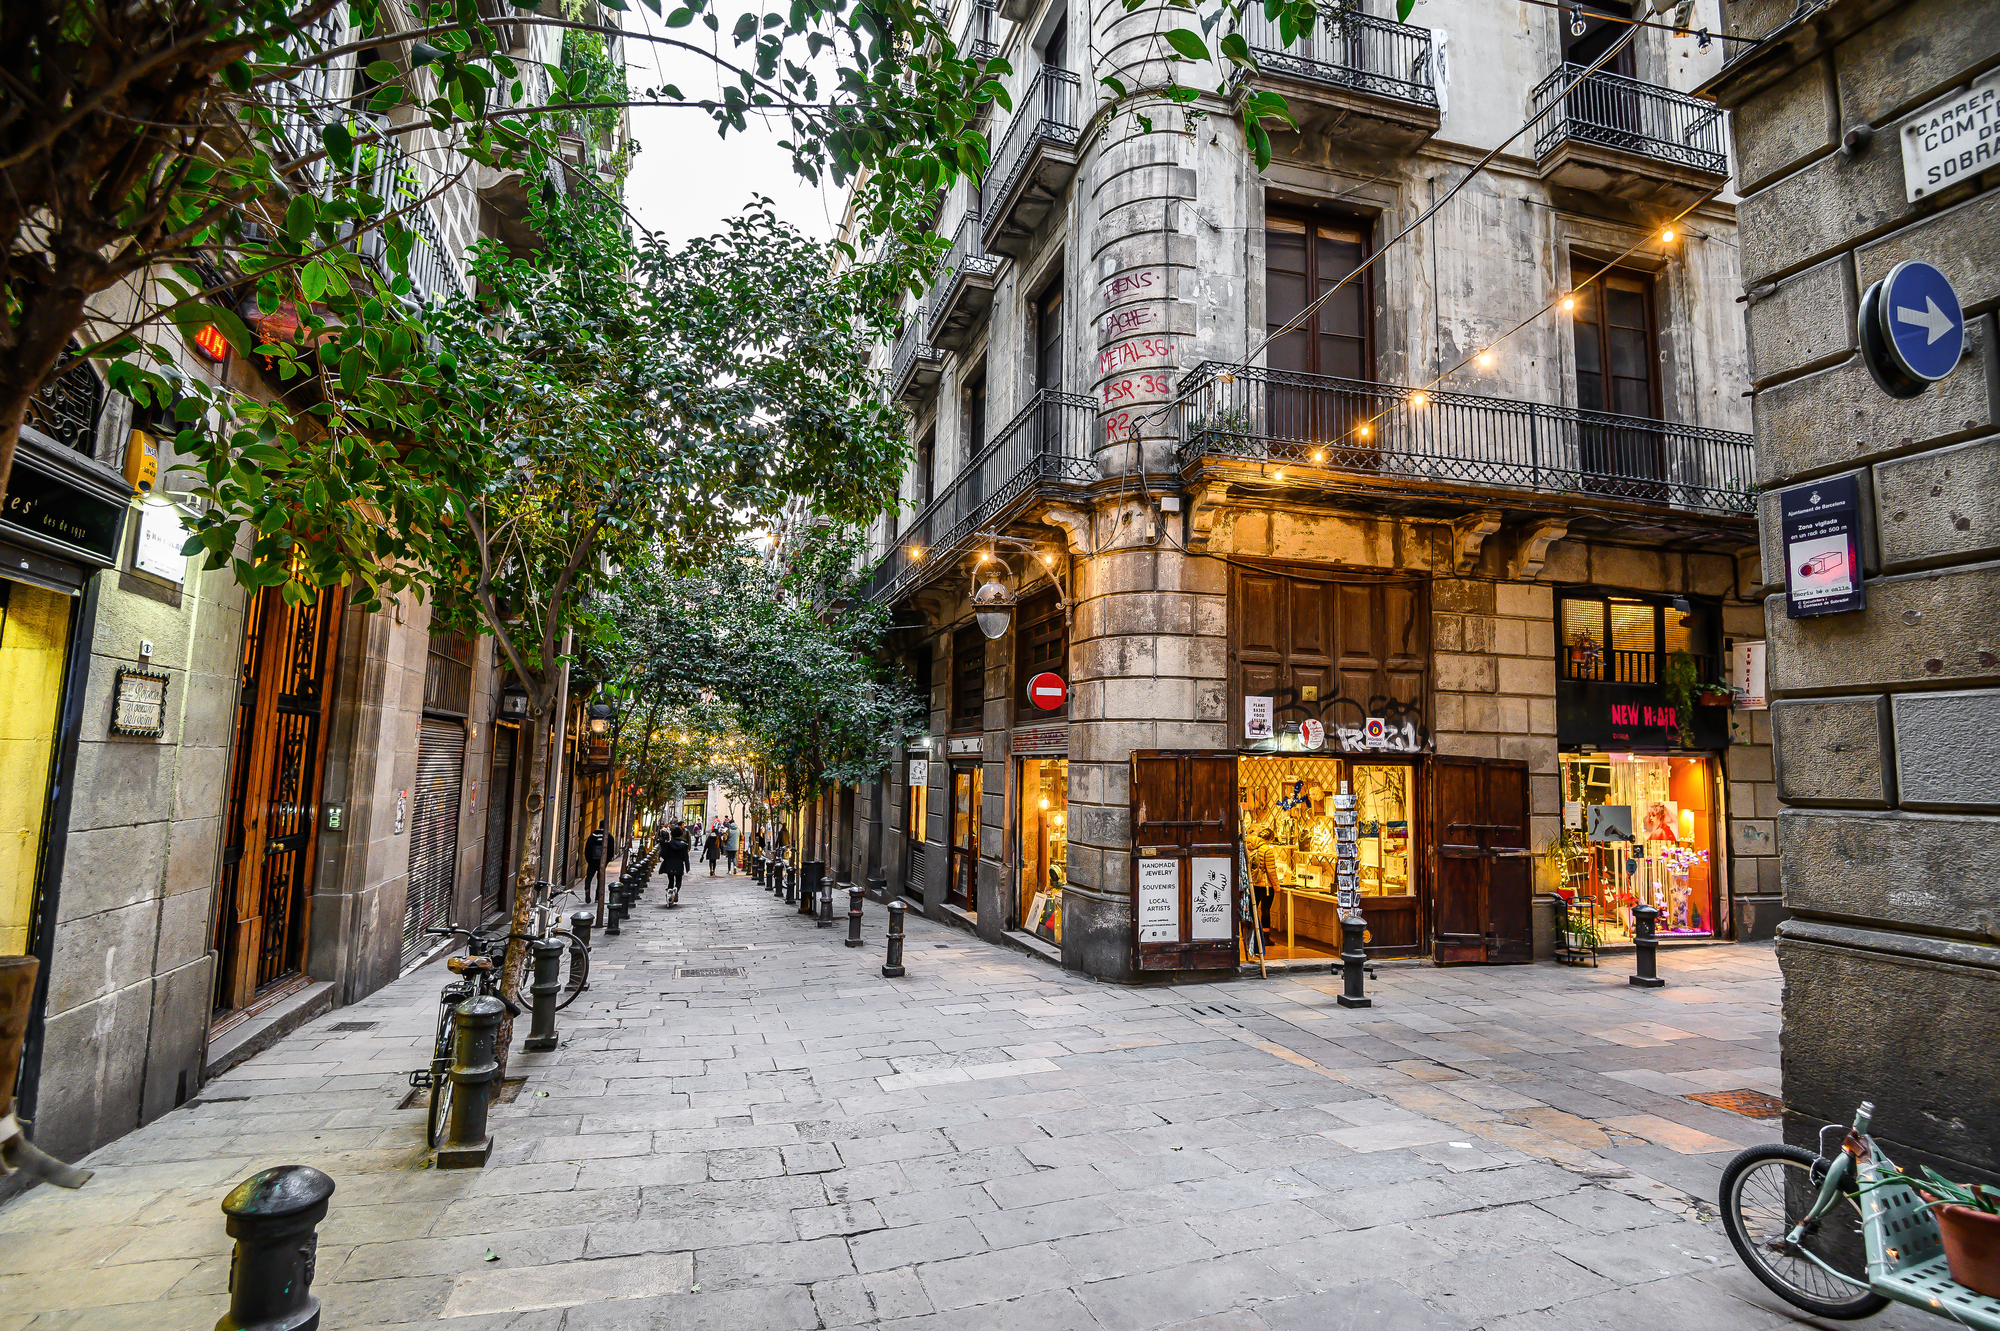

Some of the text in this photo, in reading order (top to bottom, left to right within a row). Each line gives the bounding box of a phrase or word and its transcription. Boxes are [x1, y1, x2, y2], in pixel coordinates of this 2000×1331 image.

[1917, 89, 1994, 136] CARRER
[1788, 507, 1814, 517] Ajuntament
[1822, 500, 1846, 509] Barcelona
[1814, 519, 1838, 528] vigilada
[1828, 525, 1840, 533] 500
[1612, 701, 1639, 726] NEW
[1145, 869, 1173, 877] JEWELRY
[1142, 883, 1176, 891] SOUVENIRS
